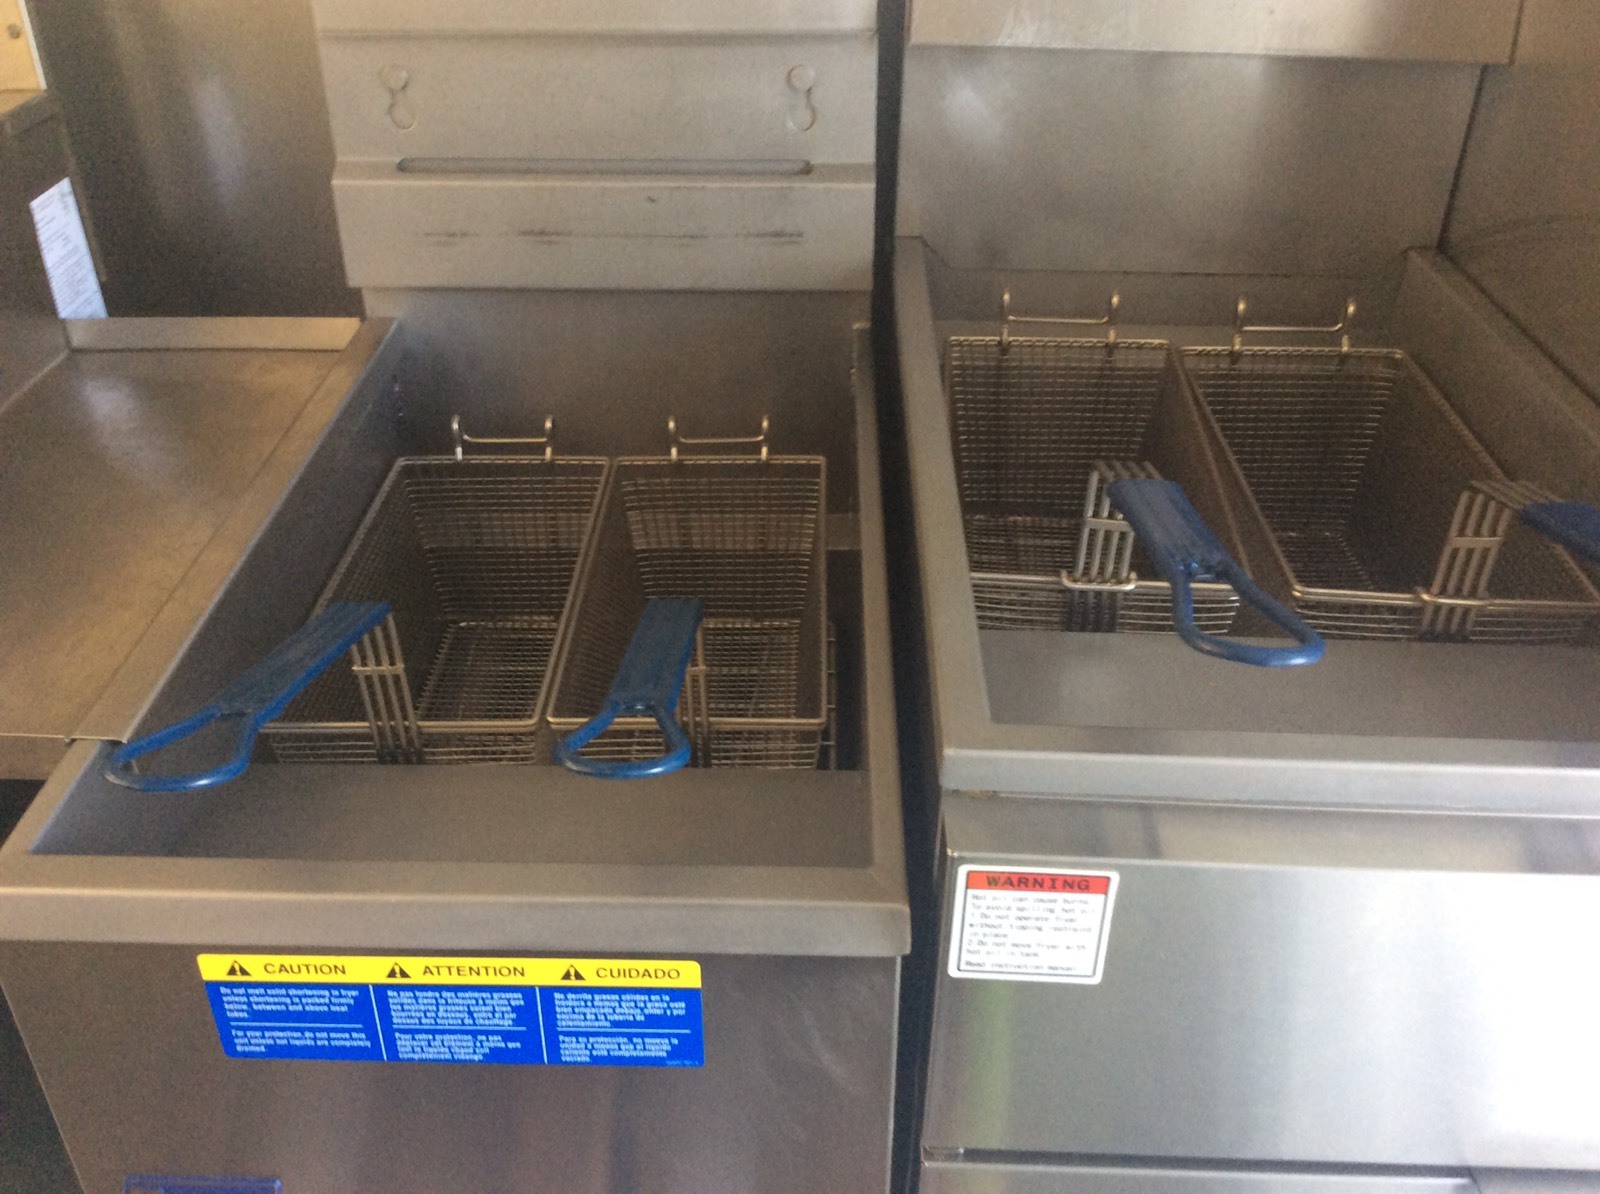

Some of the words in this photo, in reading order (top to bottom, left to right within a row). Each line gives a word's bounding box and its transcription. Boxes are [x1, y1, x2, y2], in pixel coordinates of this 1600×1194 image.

[986, 876, 1090, 891] WARNING
[264, 963, 346, 975] CAUTION
[423, 966, 525, 977] ATTENTION
[596, 968, 680, 979] CUIDADO
